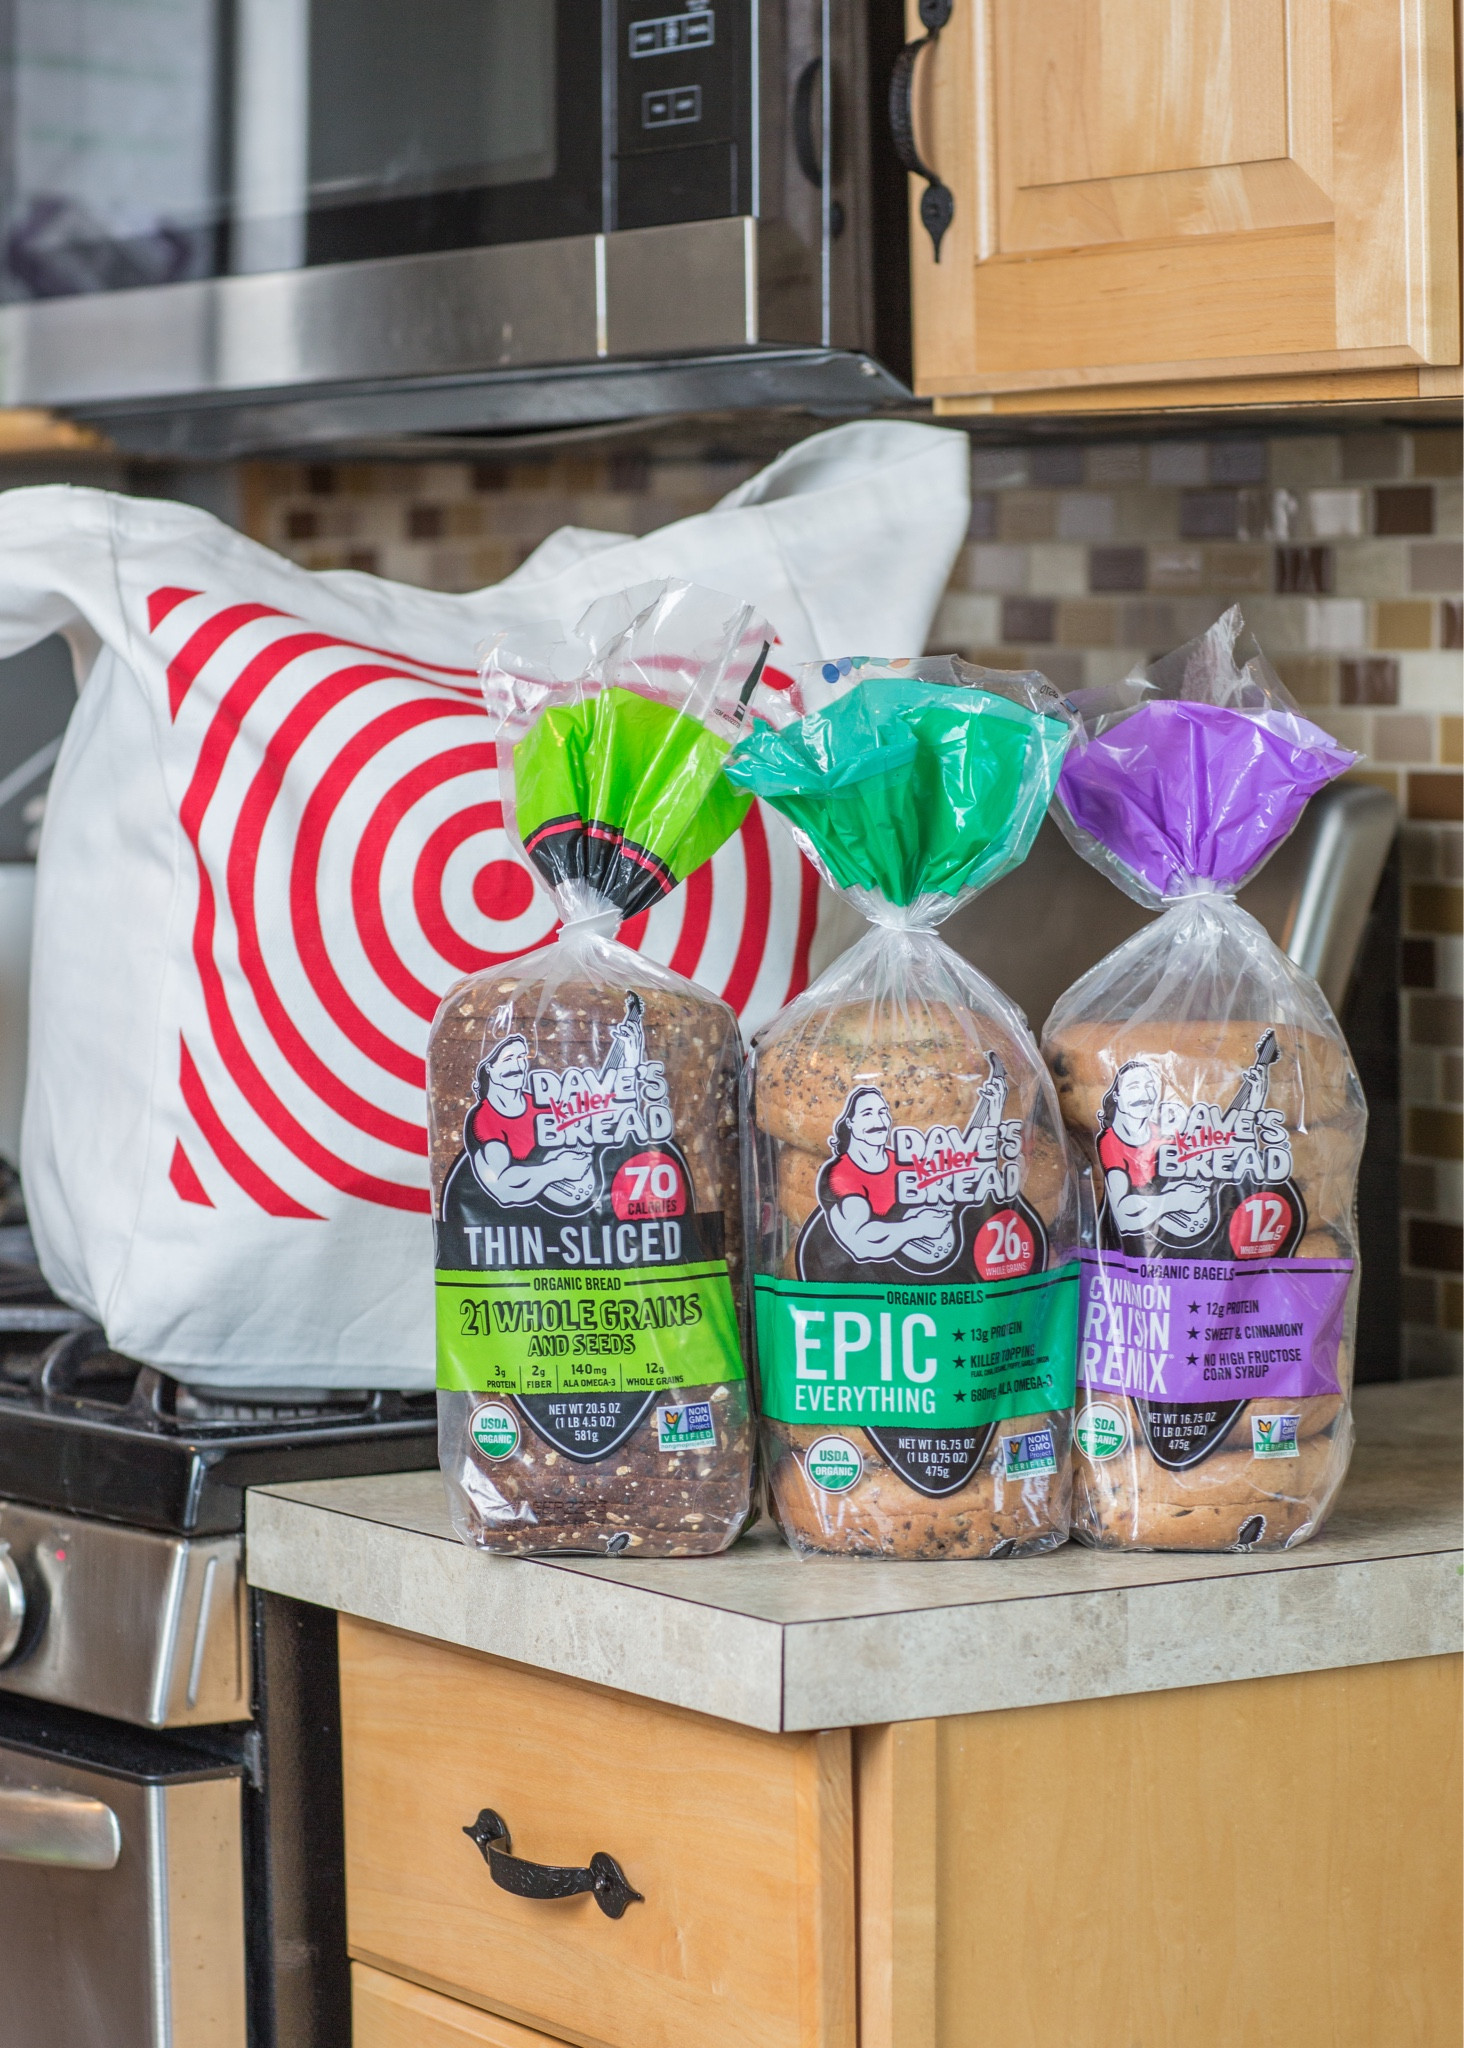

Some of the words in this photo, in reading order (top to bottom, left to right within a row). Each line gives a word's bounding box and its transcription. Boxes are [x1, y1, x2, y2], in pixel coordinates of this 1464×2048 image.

[532, 1063, 668, 1107] DAVE'S
[535, 1105, 673, 1147] BREAD
[1158, 1102, 1288, 1145] DAVE'S
[894, 1120, 1023, 1166] DAVE'S
[1157, 1145, 1292, 1182] BREAD
[625, 1164, 677, 1200] 70
[895, 1163, 1021, 1205] BREAD
[628, 1200, 677, 1215] CALORIES
[463, 1221, 682, 1265] THIN-SLICED
[1140, 1264, 1190, 1279] ORGANIC
[1193, 1266, 1235, 1281] BAGELS
[533, 1277, 582, 1291] ORGANIC
[586, 1277, 621, 1291] BREAD
[887, 1290, 937, 1306] ORGANIC
[940, 1289, 984, 1306] BAGELS
[459, 1299, 491, 1336] 21
[492, 1299, 598, 1333] WHOLE
[600, 1293, 703, 1331] GRAINS
[1206, 1302, 1225, 1318] 12g
[1226, 1299, 1260, 1315] PROTEIN
[970, 1328, 989, 1343] 13g
[990, 1320, 1022, 1339] PROTEIN
[1083, 1301, 1170, 1351] RAISIN
[1204, 1327, 1234, 1341] SWEET
[1235, 1326, 1242, 1340] &
[1244, 1322, 1304, 1339] CINNAMONY
[528, 1335, 569, 1357] AND
[572, 1334, 636, 1355] SEEDS
[795, 1310, 938, 1384] EPIC
[970, 1351, 1000, 1368] KILLER
[1203, 1353, 1216, 1367] NO
[1219, 1351, 1246, 1366] HIGH
[1247, 1348, 1302, 1364] FRUCTOSE
[494, 1366, 506, 1378] 3g
[532, 1365, 546, 1377] 2g
[646, 1362, 665, 1374] 12g
[1077, 1341, 1168, 1395] REMIX
[1203, 1366, 1232, 1381] CORN
[1234, 1364, 1269, 1379] SYRUP
[486, 1380, 516, 1389] PROTEIN
[526, 1380, 552, 1389] FIBER
[563, 1379, 579, 1388] ALA
[580, 1378, 616, 1387] OMEGA-3
[626, 1377, 654, 1387] WHOLE
[655, 1375, 684, 1385] GRAINS
[997, 1381, 1013, 1396] ALA
[1013, 1374, 1053, 1393] OMEGA-3
[795, 1384, 936, 1414] EVERYTHING
[549, 1404, 567, 1416] NET
[569, 1403, 584, 1415] WT
[585, 1403, 607, 1414] 20.5
[608, 1402, 621, 1414] OZ
[688, 1405, 708, 1416] NON
[481, 1418, 508, 1430] USDA
[555, 1417, 564, 1429] (1
[568, 1417, 580, 1428] LB
[582, 1416, 597, 1428] 4.5
[600, 1416, 616, 1428] OZ)
[688, 1414, 709, 1424] GMO
[1088, 1417, 1116, 1431] SDA
[1163, 1413, 1178, 1424] WT
[1180, 1412, 1203, 1424] 16.75
[1205, 1412, 1217, 1423] OZ
[478, 1434, 512, 1444] ORGANIC
[574, 1430, 599, 1442] 581g
[663, 1431, 712, 1442] VERIFIED
[1027, 1433, 1049, 1444] NON
[1153, 1426, 1161, 1438] (1
[1163, 1426, 1173, 1437] LB
[1174, 1426, 1192, 1437] 0.75
[1193, 1425, 1207, 1436] OZ)
[898, 1438, 916, 1450] NET
[918, 1439, 932, 1451] WT
[935, 1439, 962, 1451] 16.75
[963, 1438, 976, 1450] OZ
[1028, 1442, 1051, 1452] GMO
[1168, 1440, 1190, 1451] 475g
[819, 1450, 850, 1462] USDA
[907, 1452, 915, 1464] (1
[918, 1452, 929, 1463] LB
[931, 1452, 950, 1464] 0.75
[952, 1452, 968, 1464] OZ)
[1030, 1450, 1052, 1459] Proect
[815, 1465, 854, 1476] ORGANIC
[925, 1465, 950, 1478] 475g
[1008, 1458, 1053, 1472] VERIFIED
